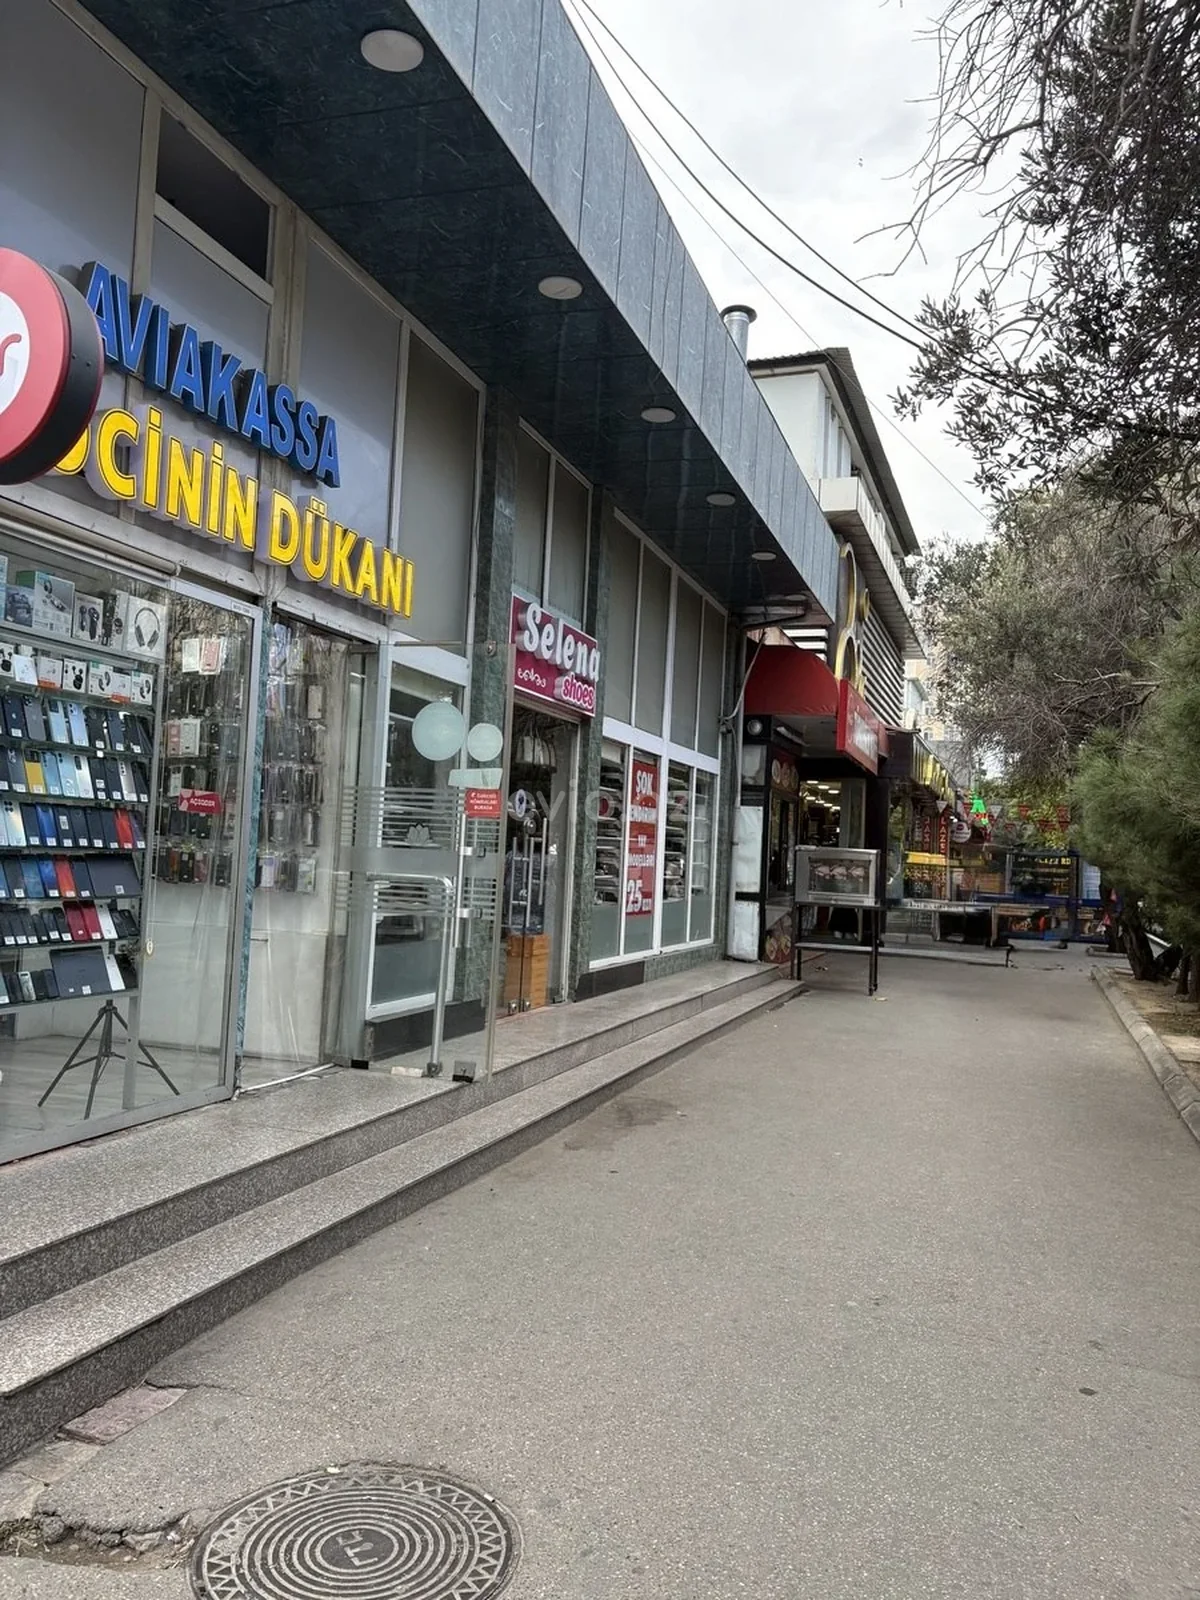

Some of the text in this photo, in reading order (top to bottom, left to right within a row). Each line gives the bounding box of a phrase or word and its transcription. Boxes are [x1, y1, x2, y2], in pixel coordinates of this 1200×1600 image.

[85, 262, 341, 487] AVIAKASSA
[268, 489, 414, 618] DÜKANI
[524, 603, 600, 683] Selena
[562, 673, 594, 708] shoes
[636, 770, 654, 801] ŞOK
[627, 879, 642, 912] 25
